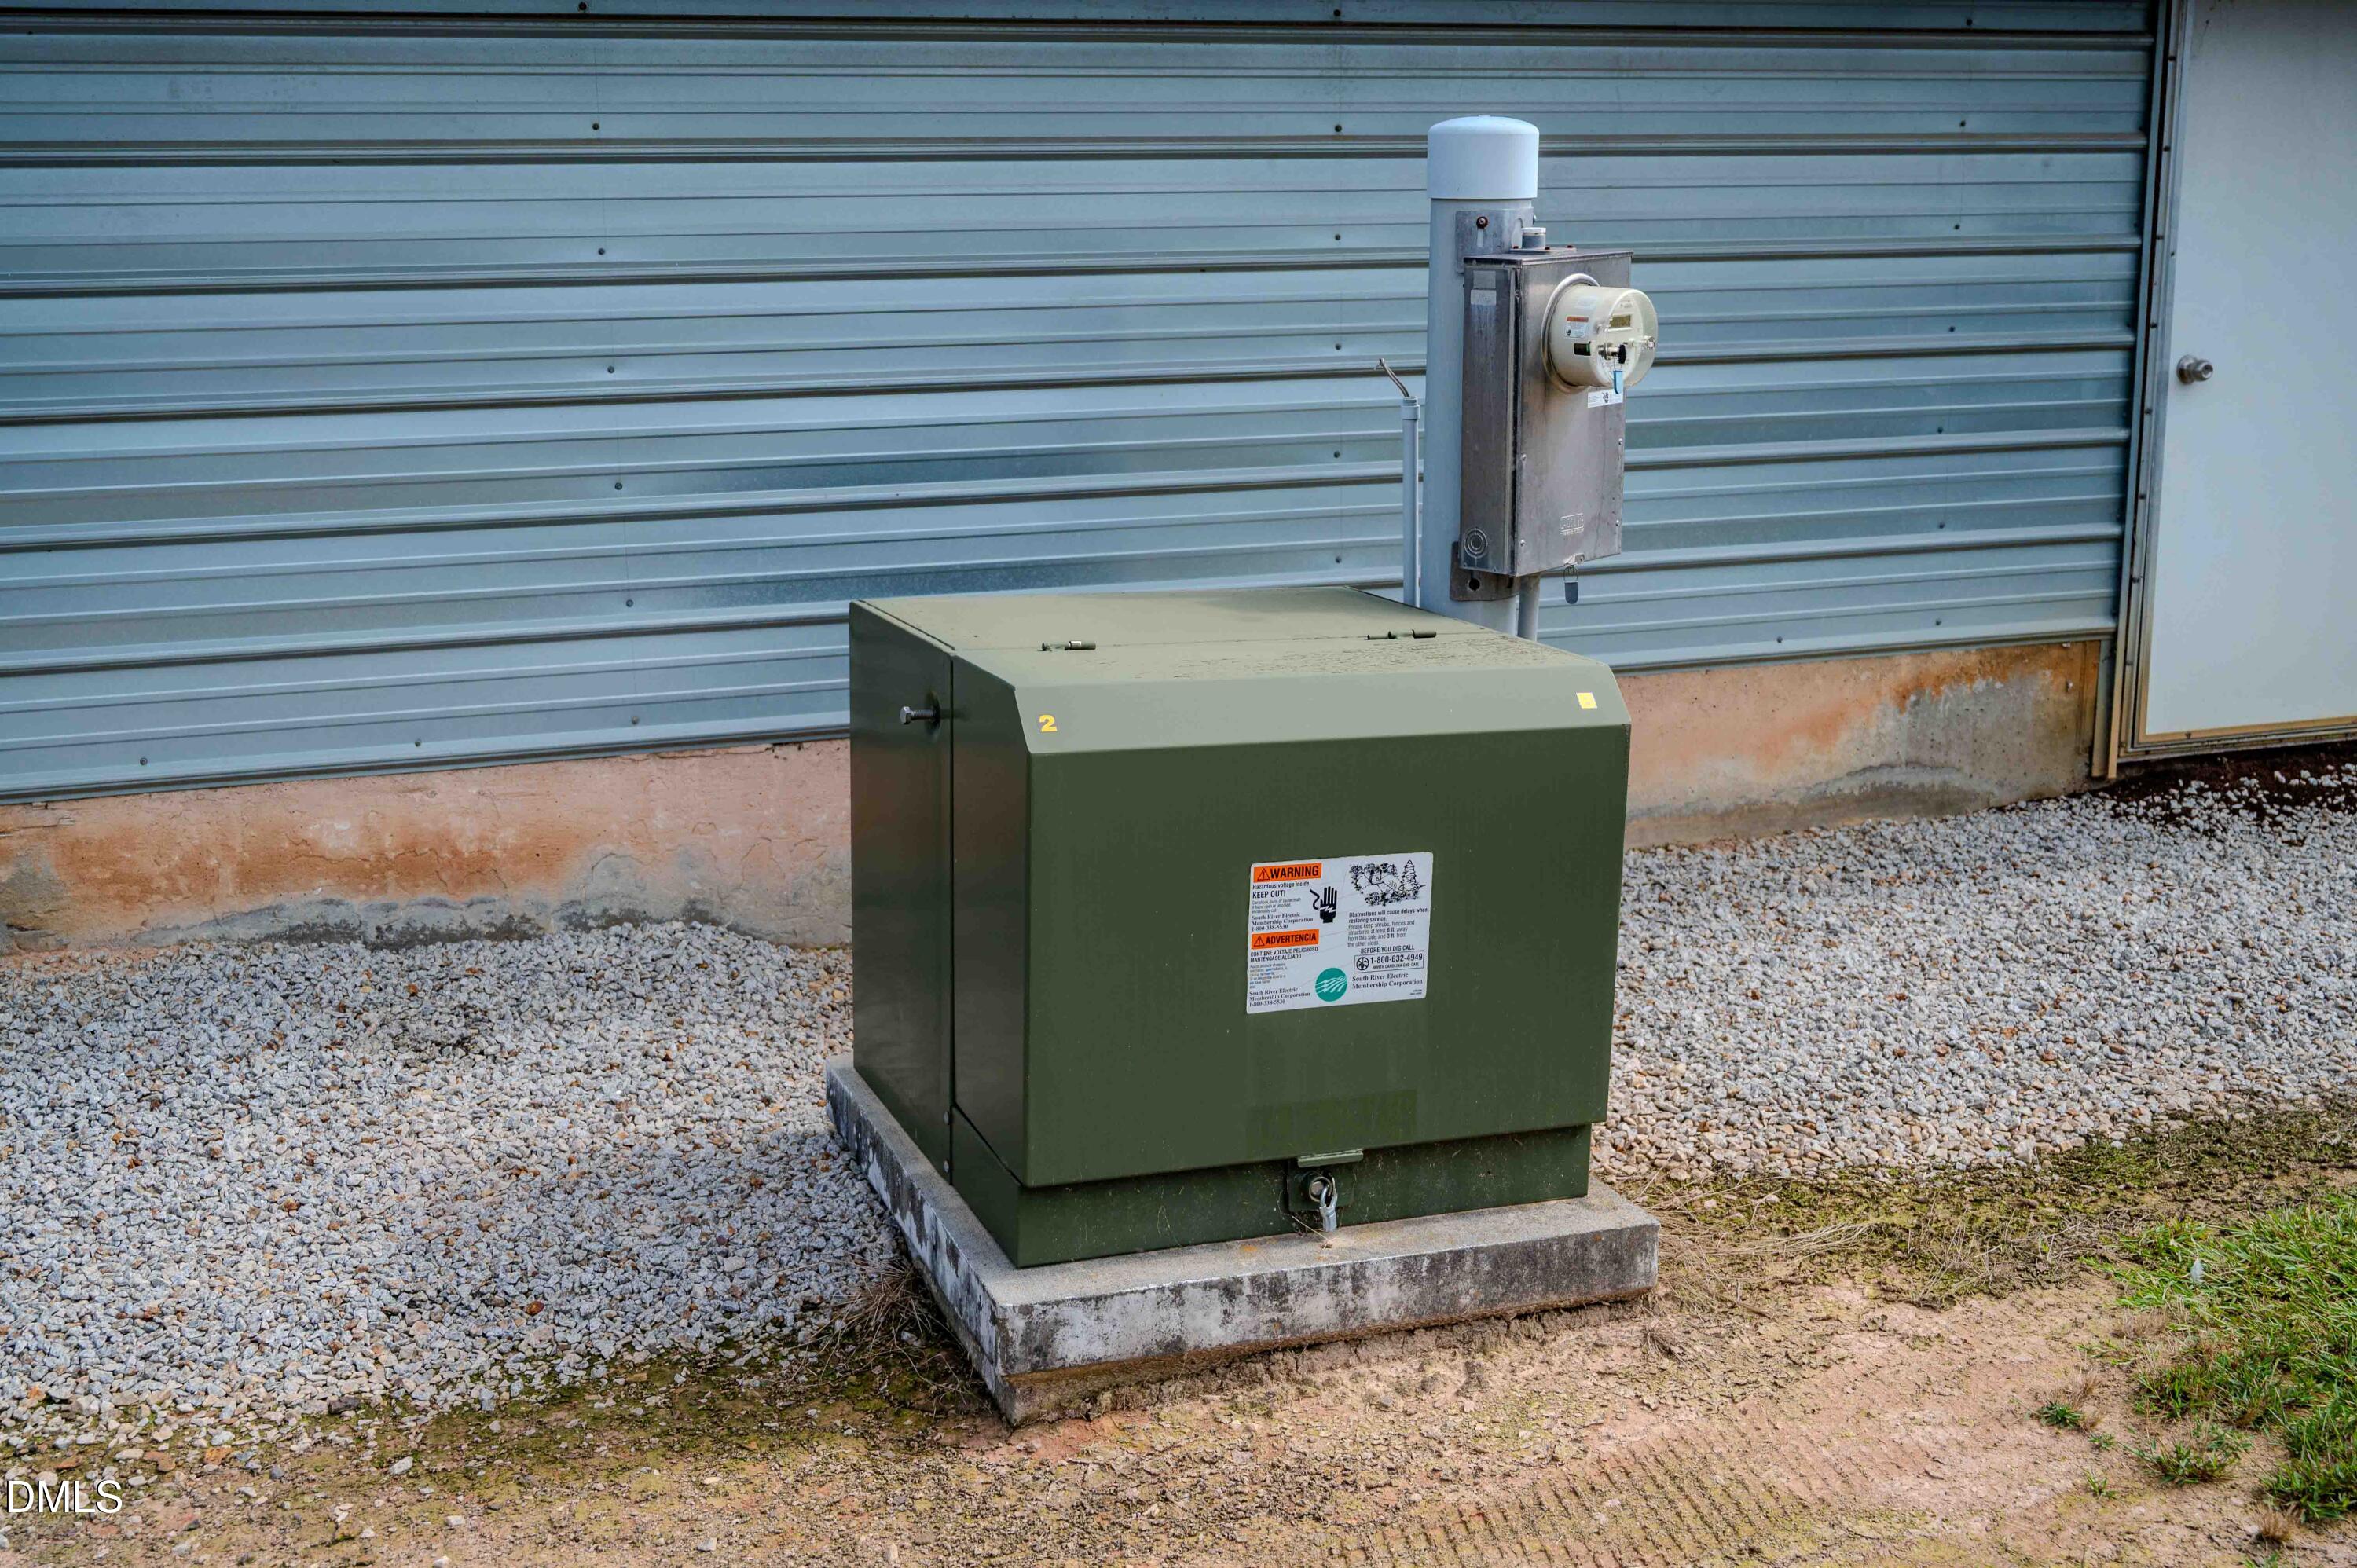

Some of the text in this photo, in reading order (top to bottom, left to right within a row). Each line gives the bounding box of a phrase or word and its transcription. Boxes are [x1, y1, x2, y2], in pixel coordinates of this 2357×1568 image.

[1039, 714, 1058, 732] 2
[1270, 865, 1319, 879] WARNING
[1265, 933, 1317, 944] ADVERTENCIA
[1370, 953, 1423, 964] 1-800-632-4949
[1352, 981, 1387, 990] Membership
